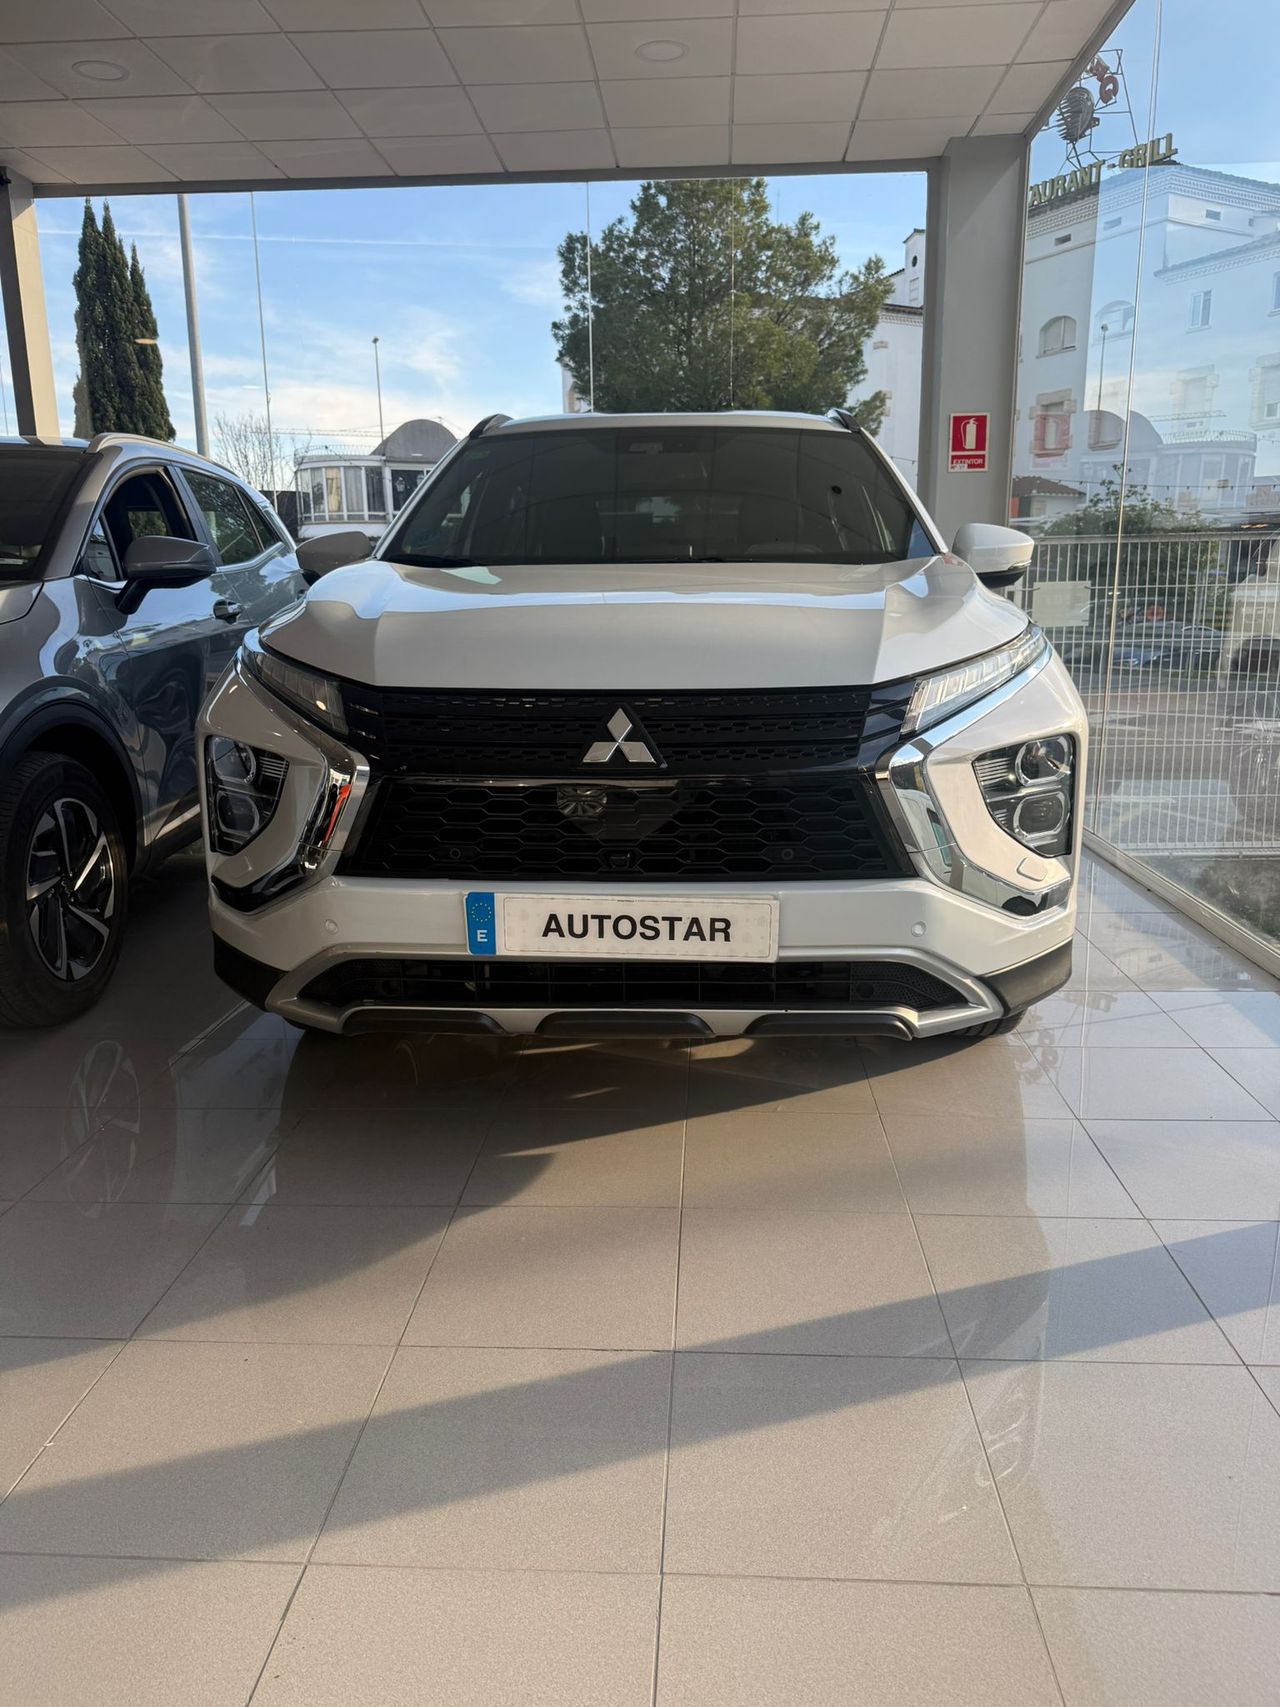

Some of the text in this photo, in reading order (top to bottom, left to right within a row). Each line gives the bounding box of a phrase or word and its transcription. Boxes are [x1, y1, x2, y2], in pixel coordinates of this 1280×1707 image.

[1028, 159, 1105, 207] AURANT
[476, 929, 488, 942] E
[542, 913, 732, 943] AUTOSTAR
